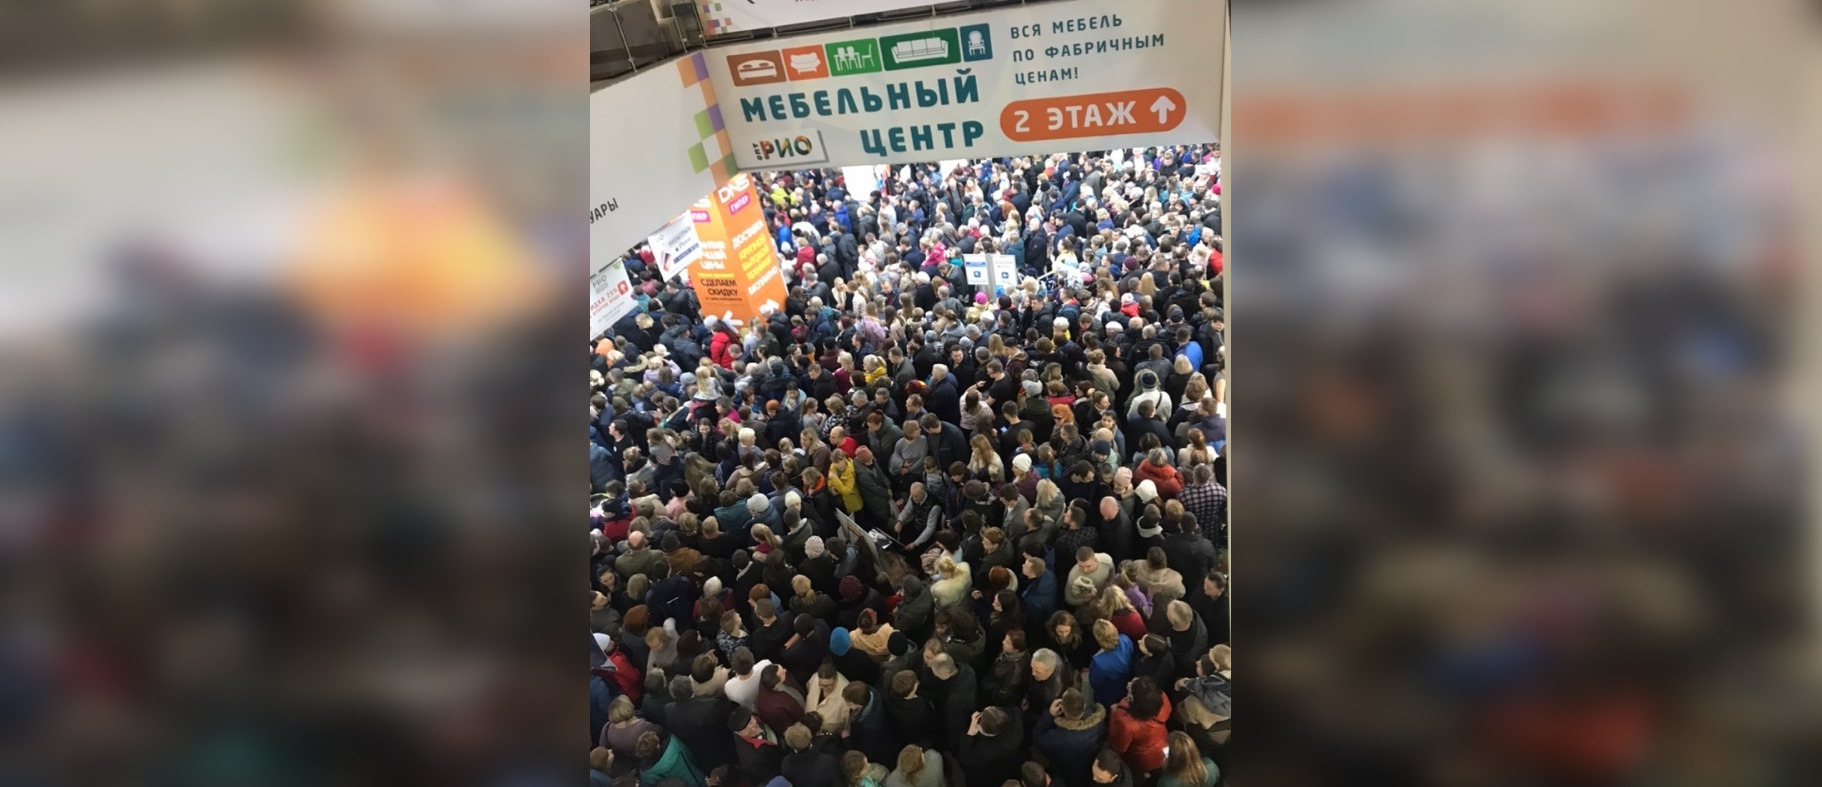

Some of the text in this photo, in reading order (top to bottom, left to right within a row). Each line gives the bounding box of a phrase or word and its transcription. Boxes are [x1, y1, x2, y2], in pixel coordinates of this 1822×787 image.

[1010, 14, 1123, 39] ВСЯ МЕБЕЛЬ
[1013, 33, 1165, 62] ПО ФАБРИЧНЫМ
[1015, 67, 1079, 86] ЦЕНАМ!
[740, 67, 980, 123] МЕБЕЛЬНЫЙ
[1014, 101, 1137, 133] 2 ЭТАЖ
[759, 135, 813, 160] РИО
[859, 120, 984, 158] ЦЕНТР
[718, 172, 751, 204] DNS
[730, 193, 750, 213] ГИПЕР
[700, 278, 737, 288] СДЕЛАЕМ
[707, 287, 738, 297] СКИДКУ
